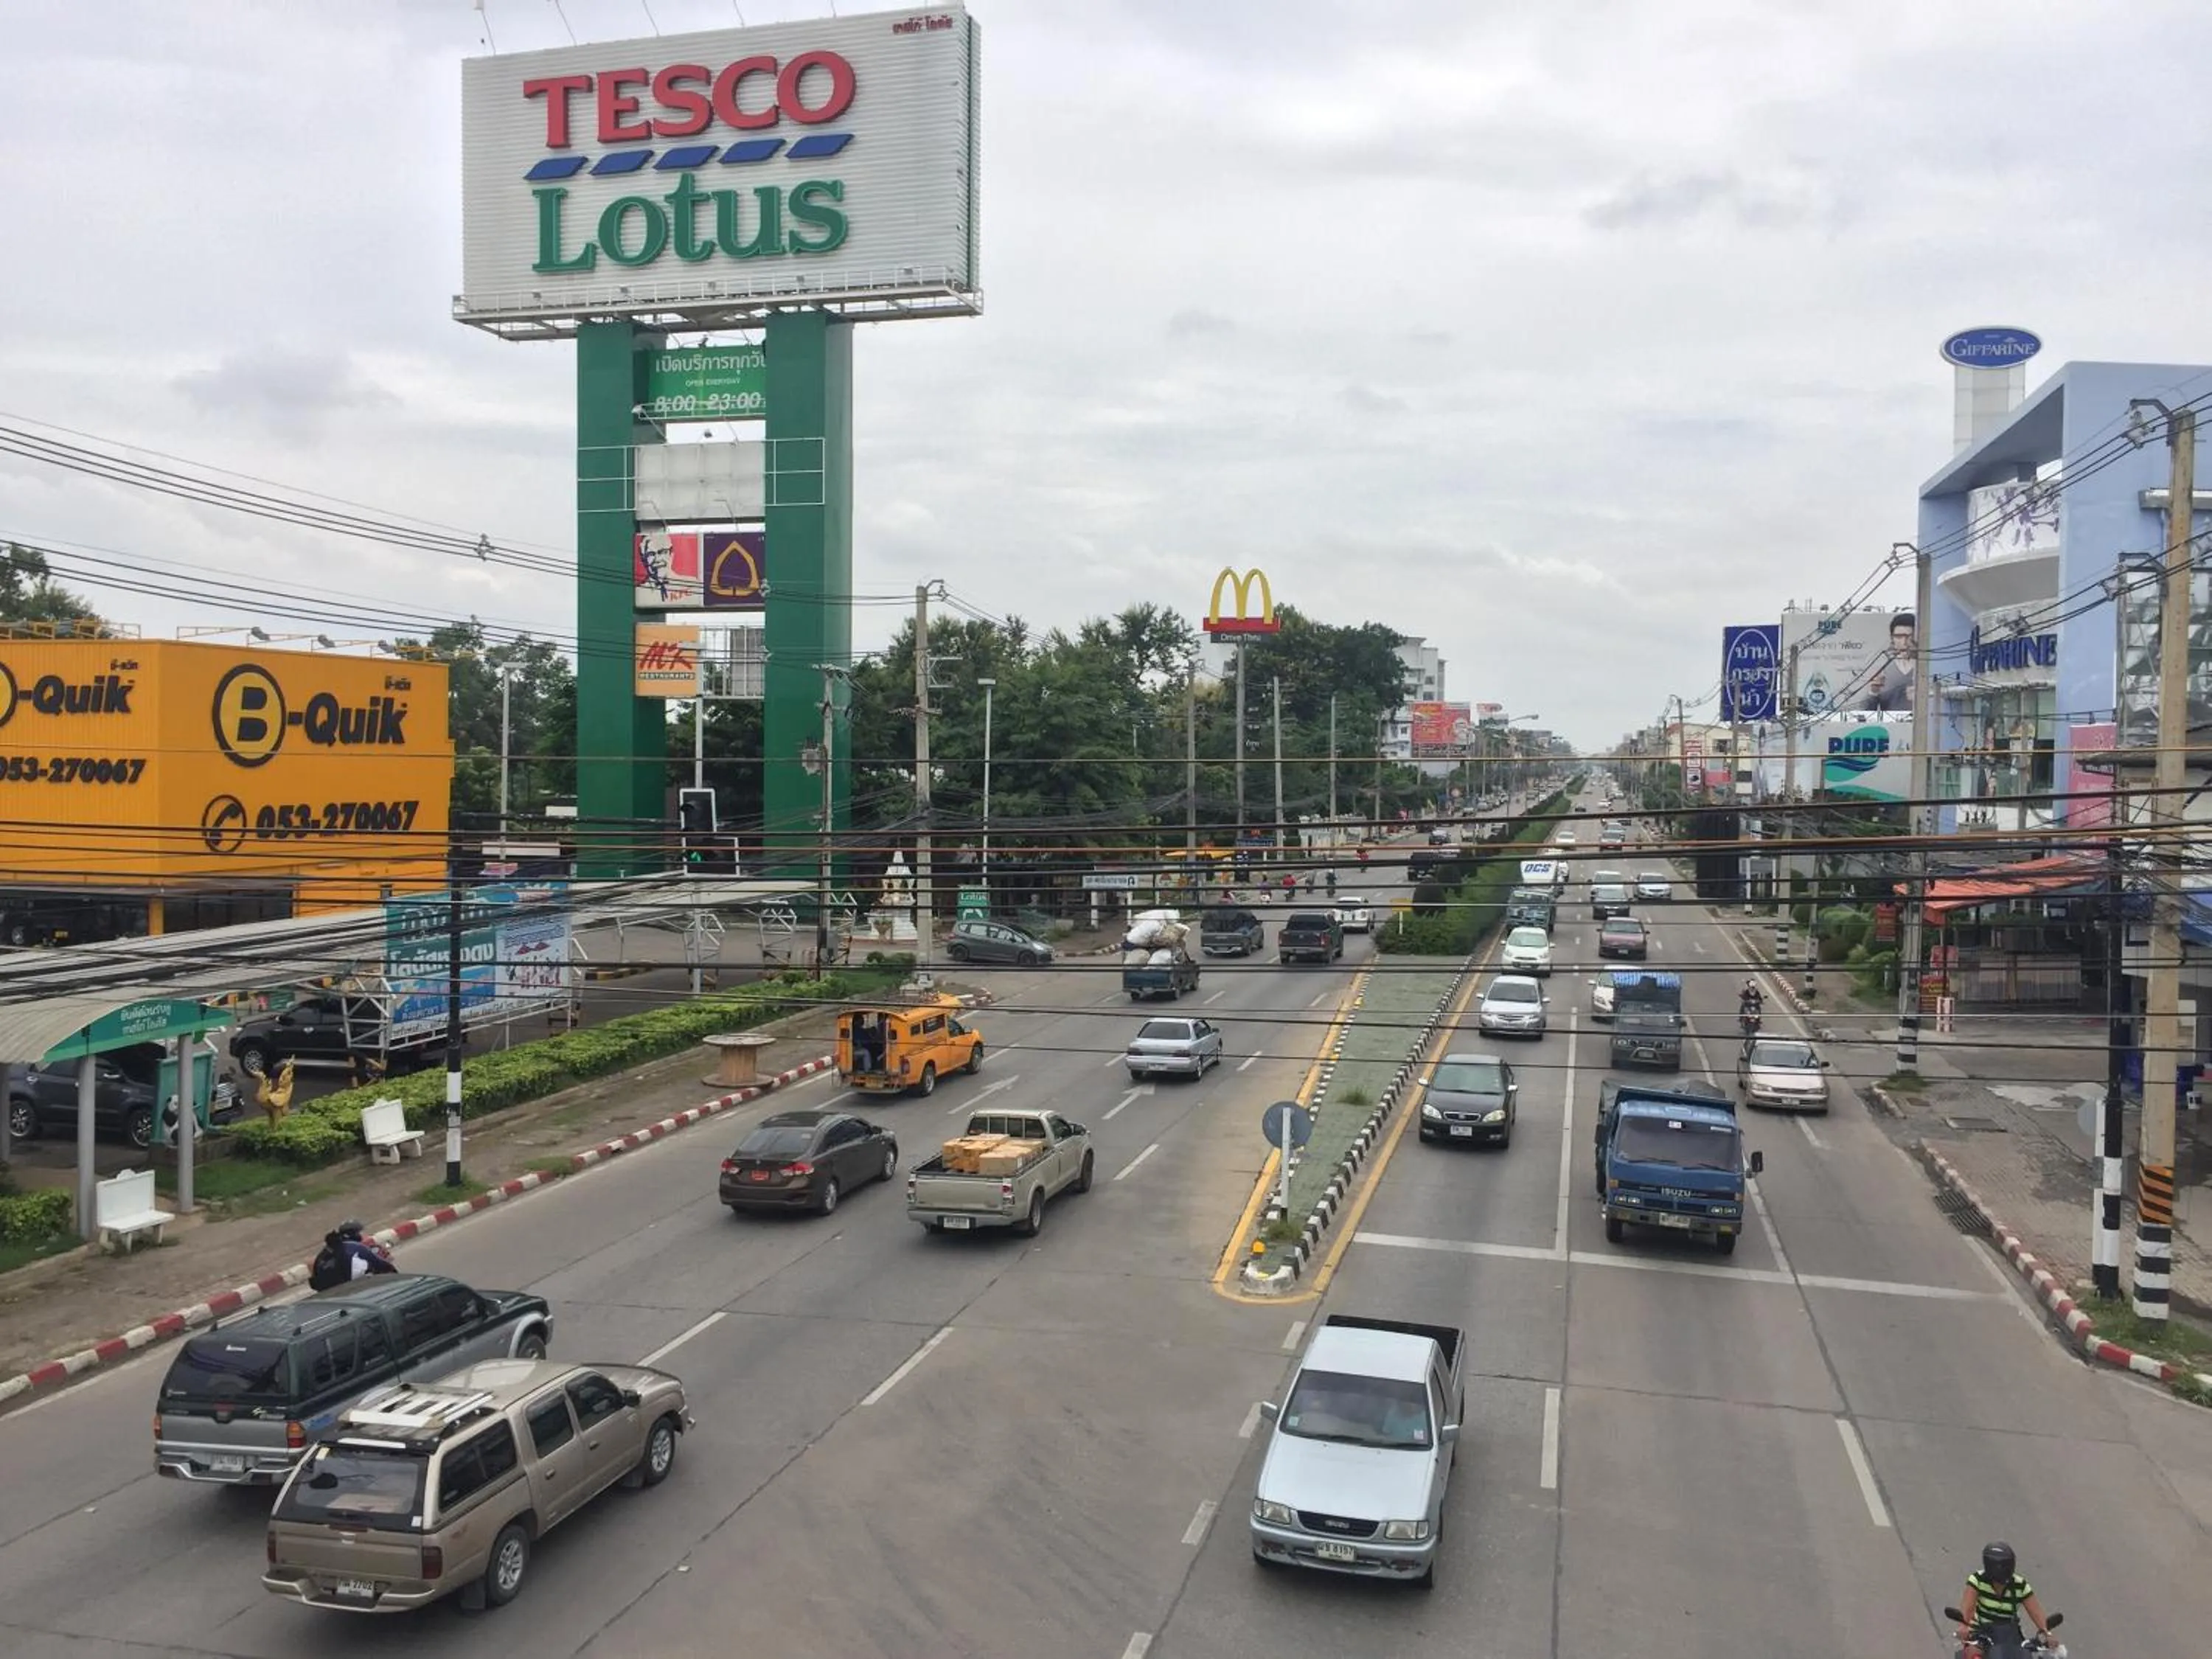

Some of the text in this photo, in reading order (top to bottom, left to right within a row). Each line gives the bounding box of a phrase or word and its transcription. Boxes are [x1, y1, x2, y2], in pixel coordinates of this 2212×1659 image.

[524, 50, 856, 148] TESCO
[532, 173, 849, 273] Lotus
[256, 800, 420, 839] 053-270067
[1661, 1186, 1691, 1197] ISUZU
